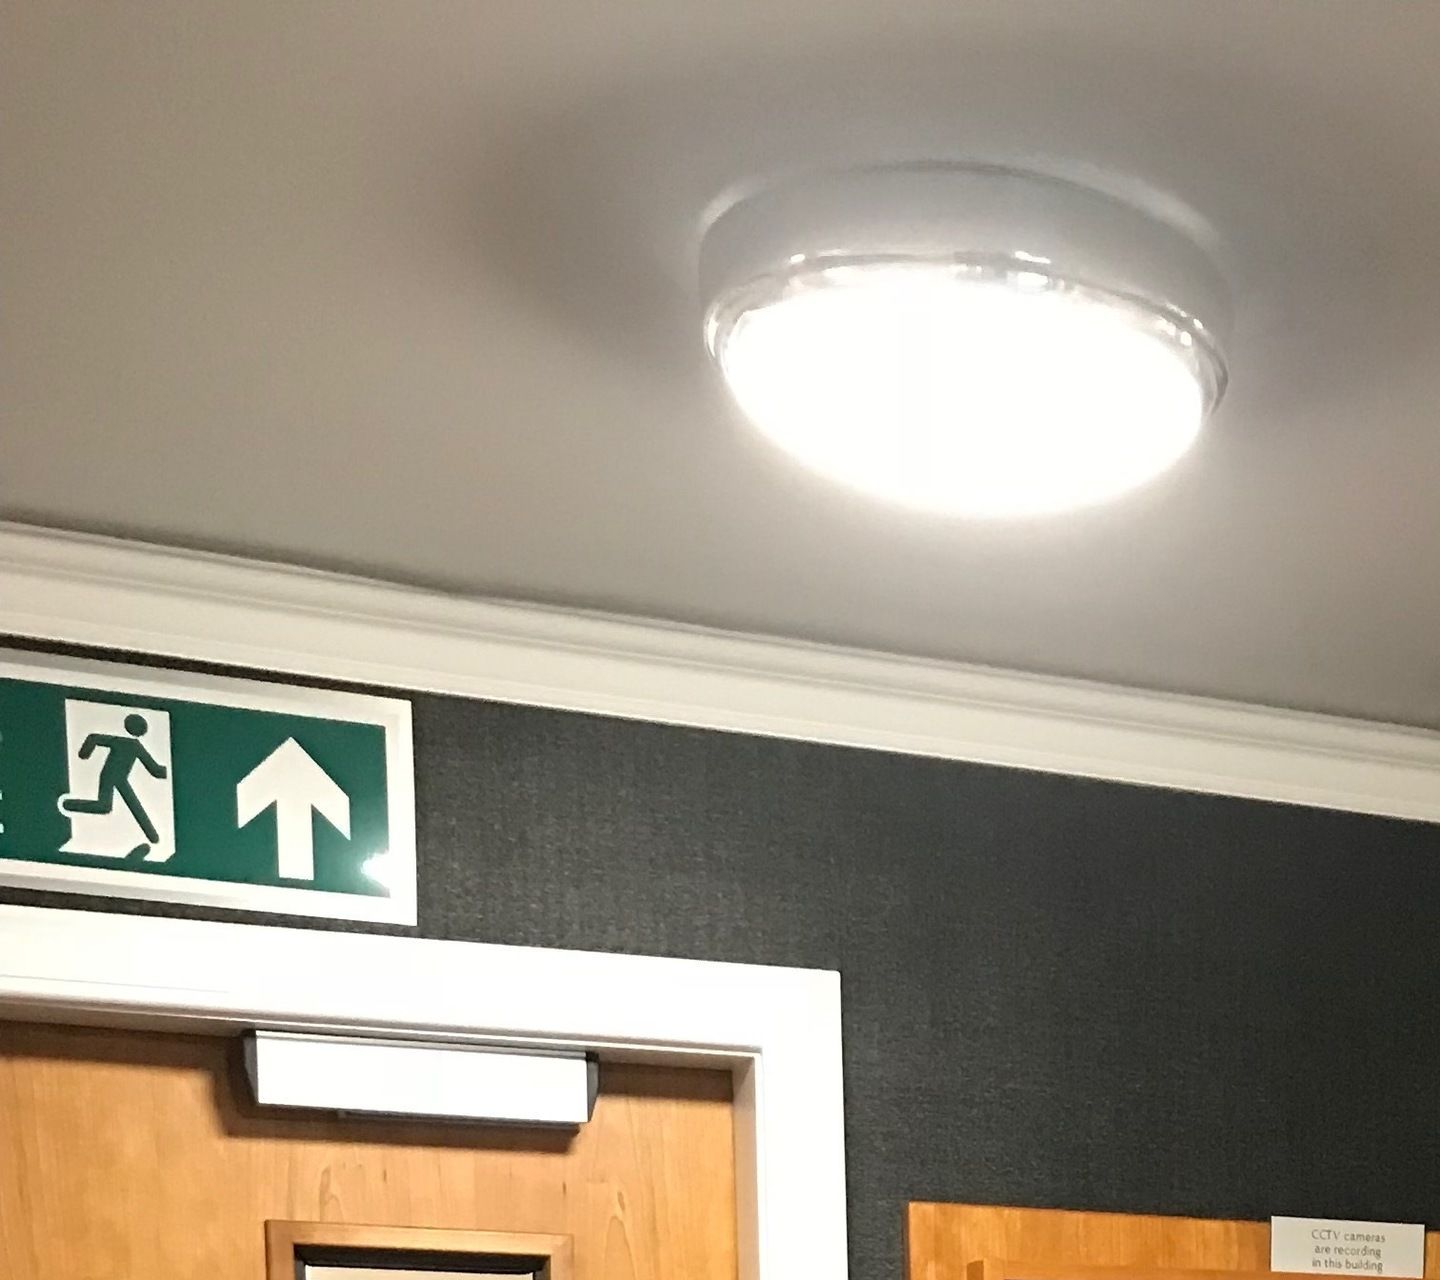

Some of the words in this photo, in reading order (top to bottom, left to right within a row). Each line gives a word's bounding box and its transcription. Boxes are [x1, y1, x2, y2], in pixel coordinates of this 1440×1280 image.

[1311, 1229, 1341, 1241] CCTV
[1343, 1232, 1386, 1243] cameras
[1333, 1246, 1382, 1259] recording
[1312, 1258, 1321, 1268] in
[1324, 1259, 1342, 1269] this
[1345, 1260, 1384, 1273] building
